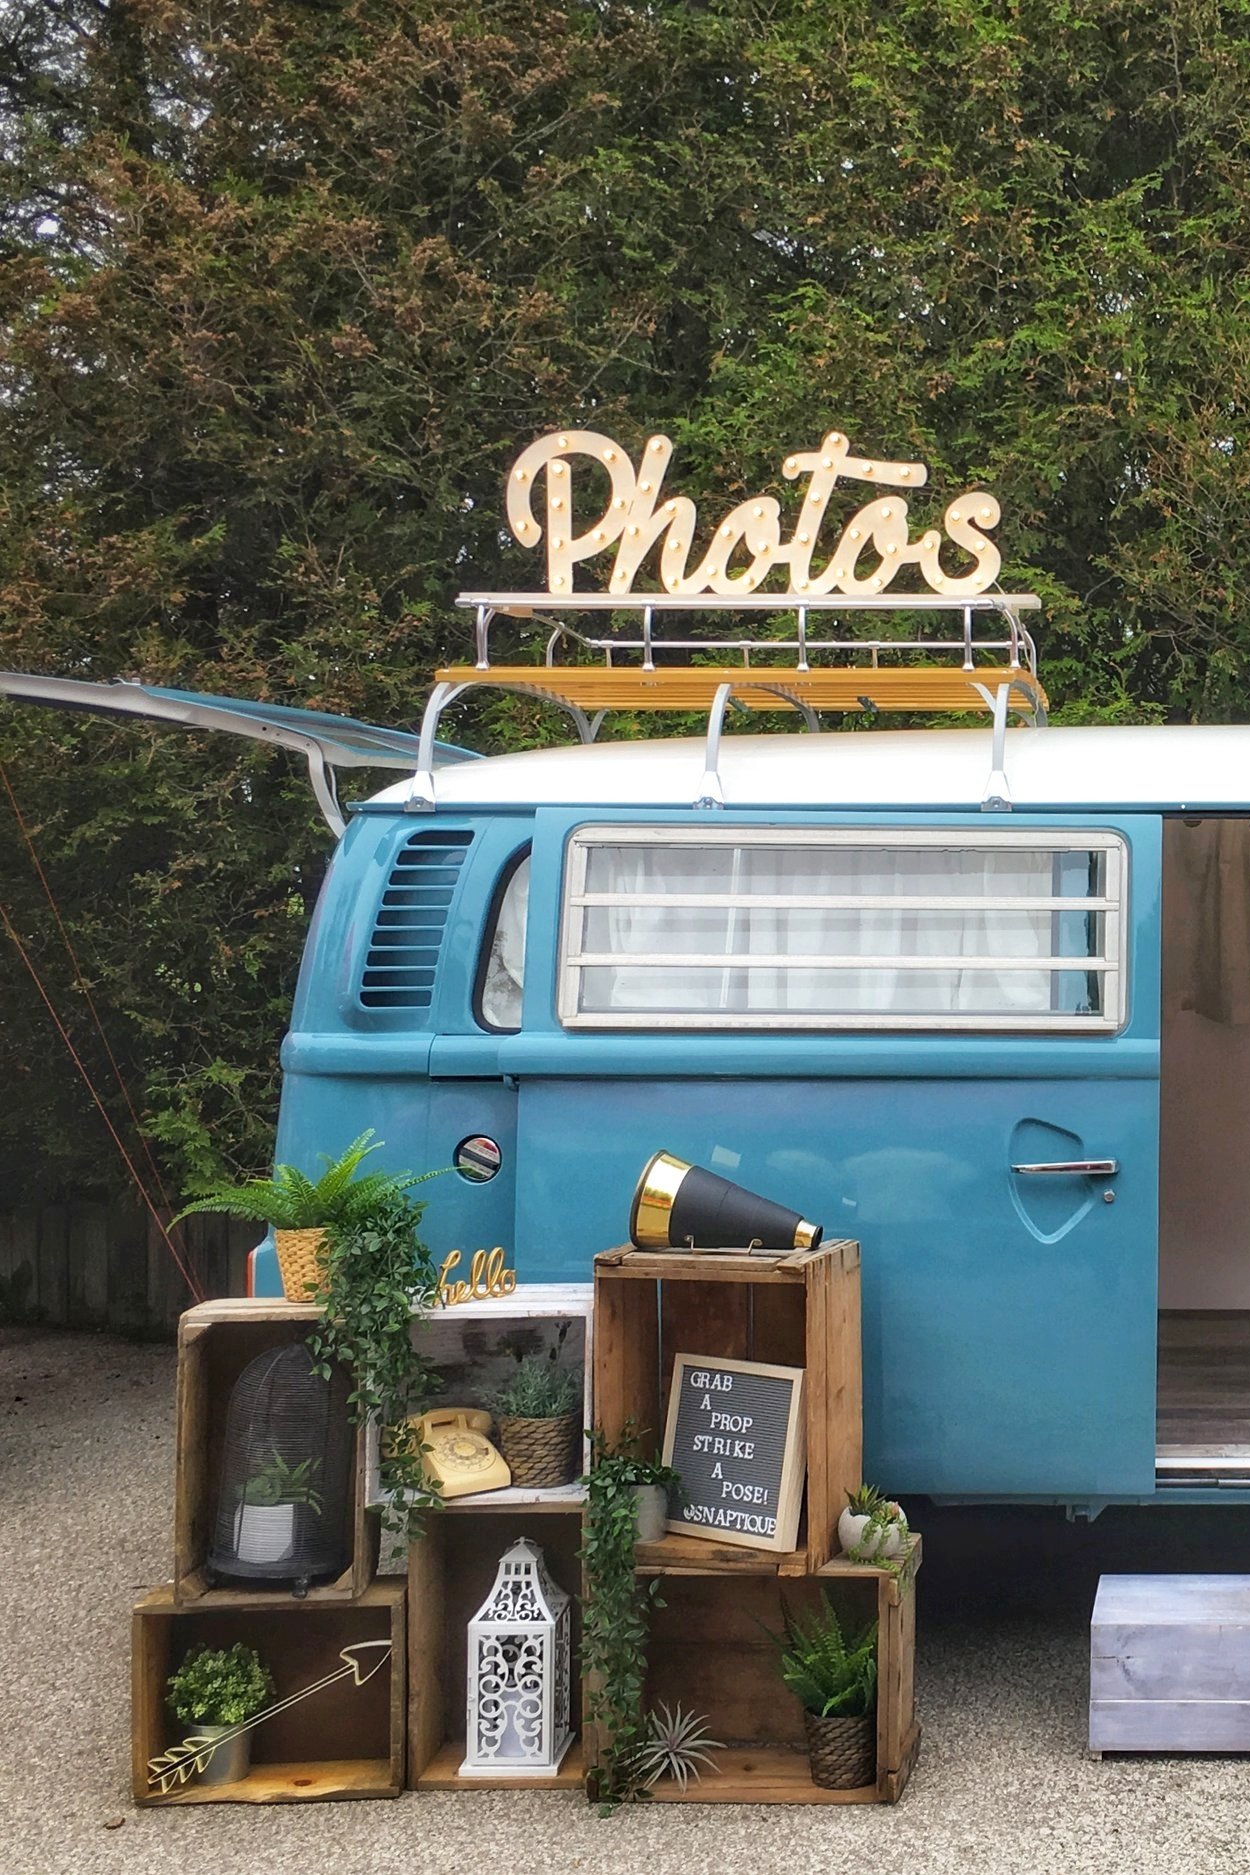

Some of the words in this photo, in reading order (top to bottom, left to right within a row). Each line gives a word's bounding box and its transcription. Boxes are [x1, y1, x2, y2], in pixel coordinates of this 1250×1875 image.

[506, 430, 1001, 595] Photos
[432, 1246, 517, 1307] hello
[690, 1371, 733, 1392] GRAB
[701, 1394, 711, 1409] A
[711, 1413, 752, 1433] PROP
[694, 1435, 754, 1459] STRIKE
[712, 1463, 722, 1479] A
[722, 1482, 768, 1504] POSE!
[684, 1505, 776, 1534] @SNAPTIQUE
